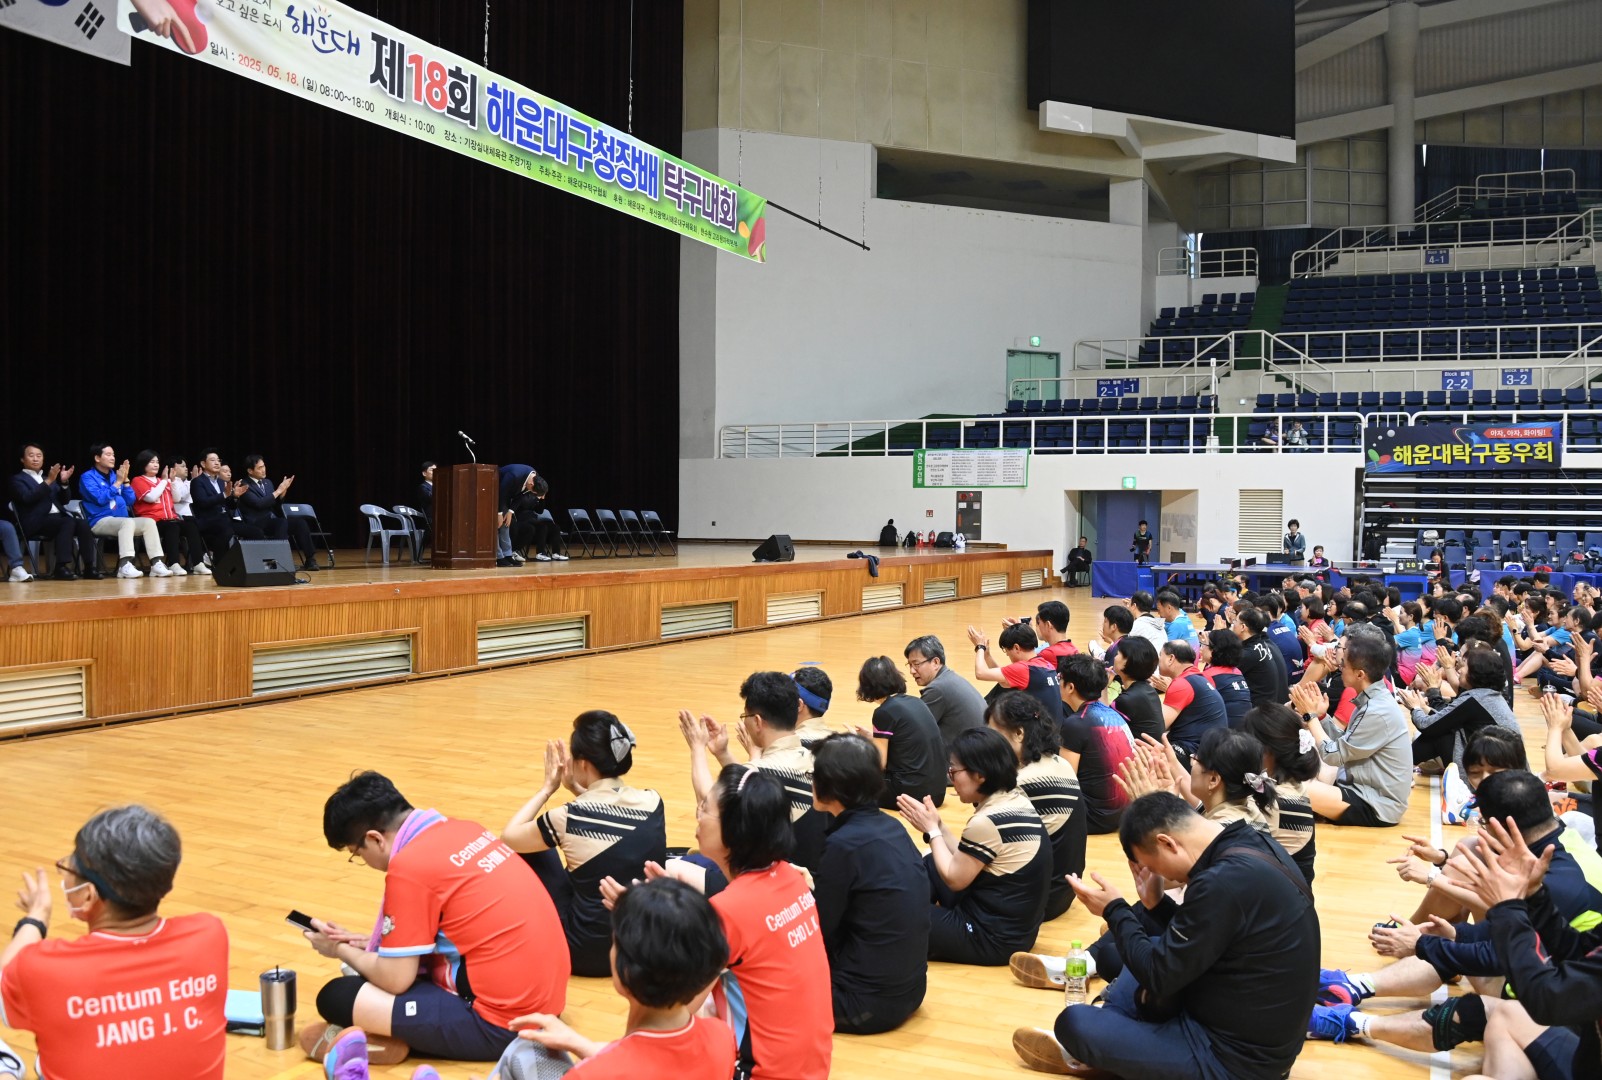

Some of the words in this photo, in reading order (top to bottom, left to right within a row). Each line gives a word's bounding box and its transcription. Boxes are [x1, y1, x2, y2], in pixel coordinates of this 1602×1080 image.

[240, 4, 259, 23] 싶은
[262, 13, 281, 32] 도시
[285, 5, 360, 56] 해운대
[210, 42, 228, 59] 일시
[238, 54, 264, 74] 2025.
[267, 64, 282, 80] 05.
[286, 71, 299, 86] 18.
[302, 76, 317, 93] (일)
[320, 83, 375, 113] 08:00~18:00
[385, 108, 406, 125] 개회식
[415, 119, 436, 135] 10:00
[444, 129, 457, 143] 장소
[369, 31, 478, 128] 제18회
[485, 81, 659, 200] 해운대구청장배
[663, 160, 737, 232] 탁구대회
[1429, 256, 1444, 264] 4-1
[1100, 387, 1119, 397] 2-1
[1446, 379, 1468, 390] 2-2
[1506, 375, 1527, 385] 3-2
[1393, 441, 1553, 466] 해운대탁구동우회
[449, 834, 492, 867] Centum
[765, 902, 803, 932] Centum
[787, 924, 807, 948] CHO
[66, 987, 162, 1019] Centum
[169, 974, 218, 1001] Edge
[96, 1018, 155, 1048] JANG
[162, 1013, 178, 1035] J.
[184, 1006, 203, 1030] C.
